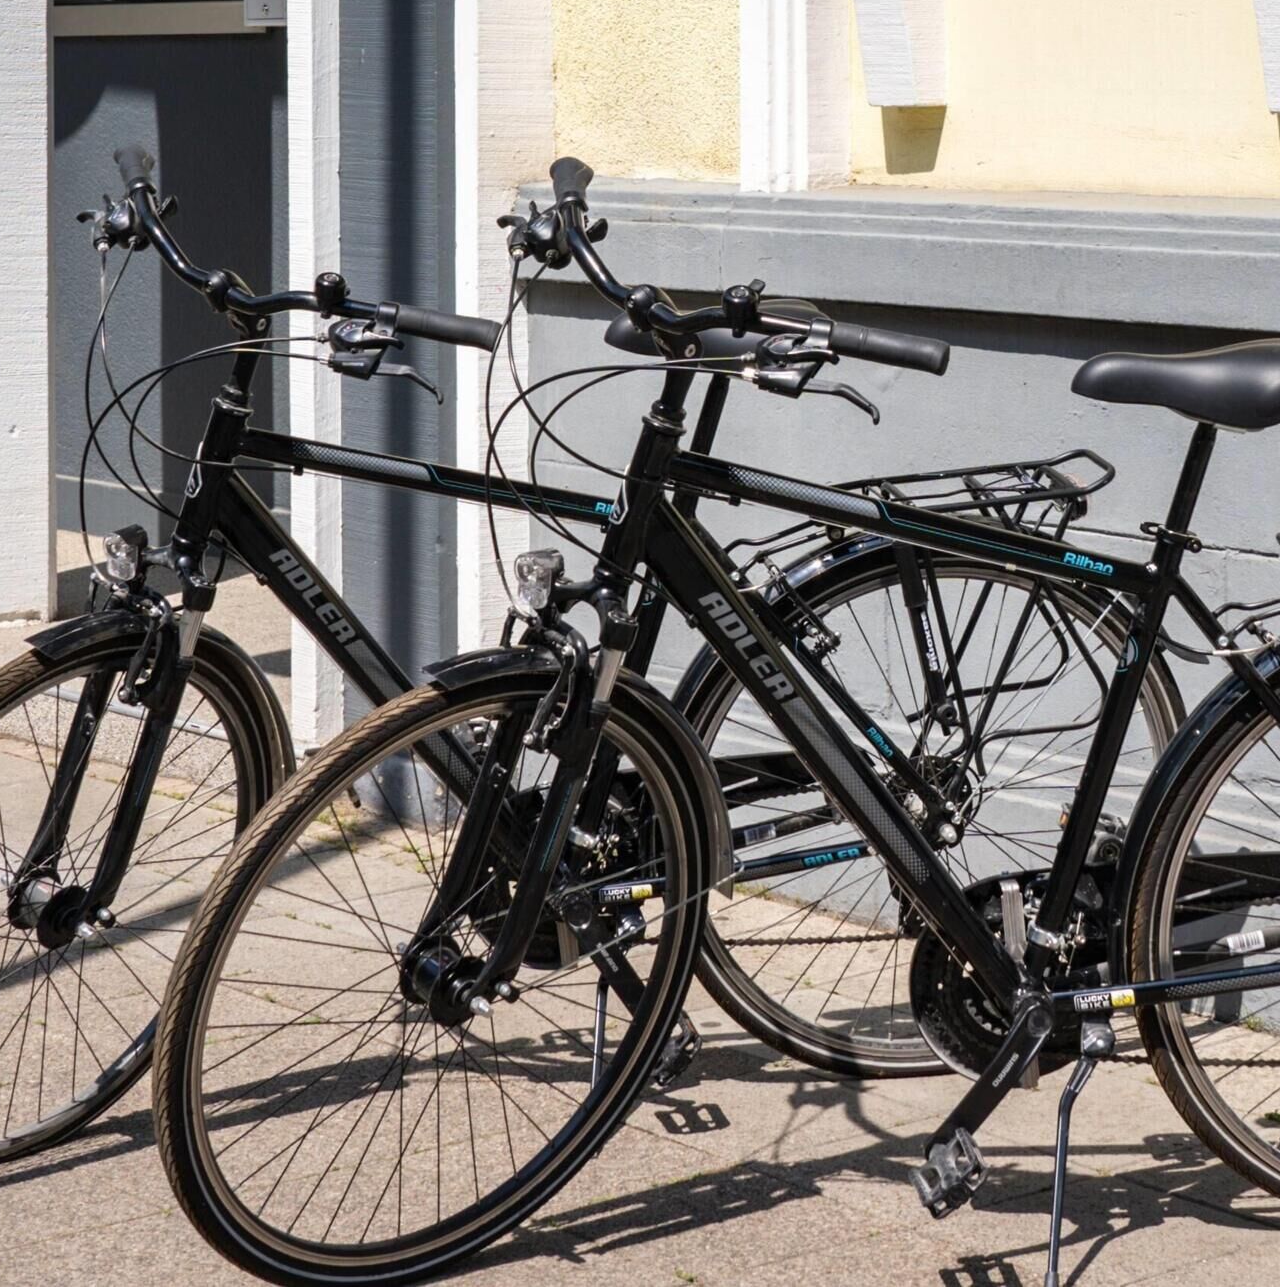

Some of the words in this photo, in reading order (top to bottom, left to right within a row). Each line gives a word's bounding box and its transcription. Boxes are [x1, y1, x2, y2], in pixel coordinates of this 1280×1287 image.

[267, 548, 356, 644] ADLER
[697, 591, 795, 701] ADLER
[1080, 993, 1110, 1003] LUCKY
